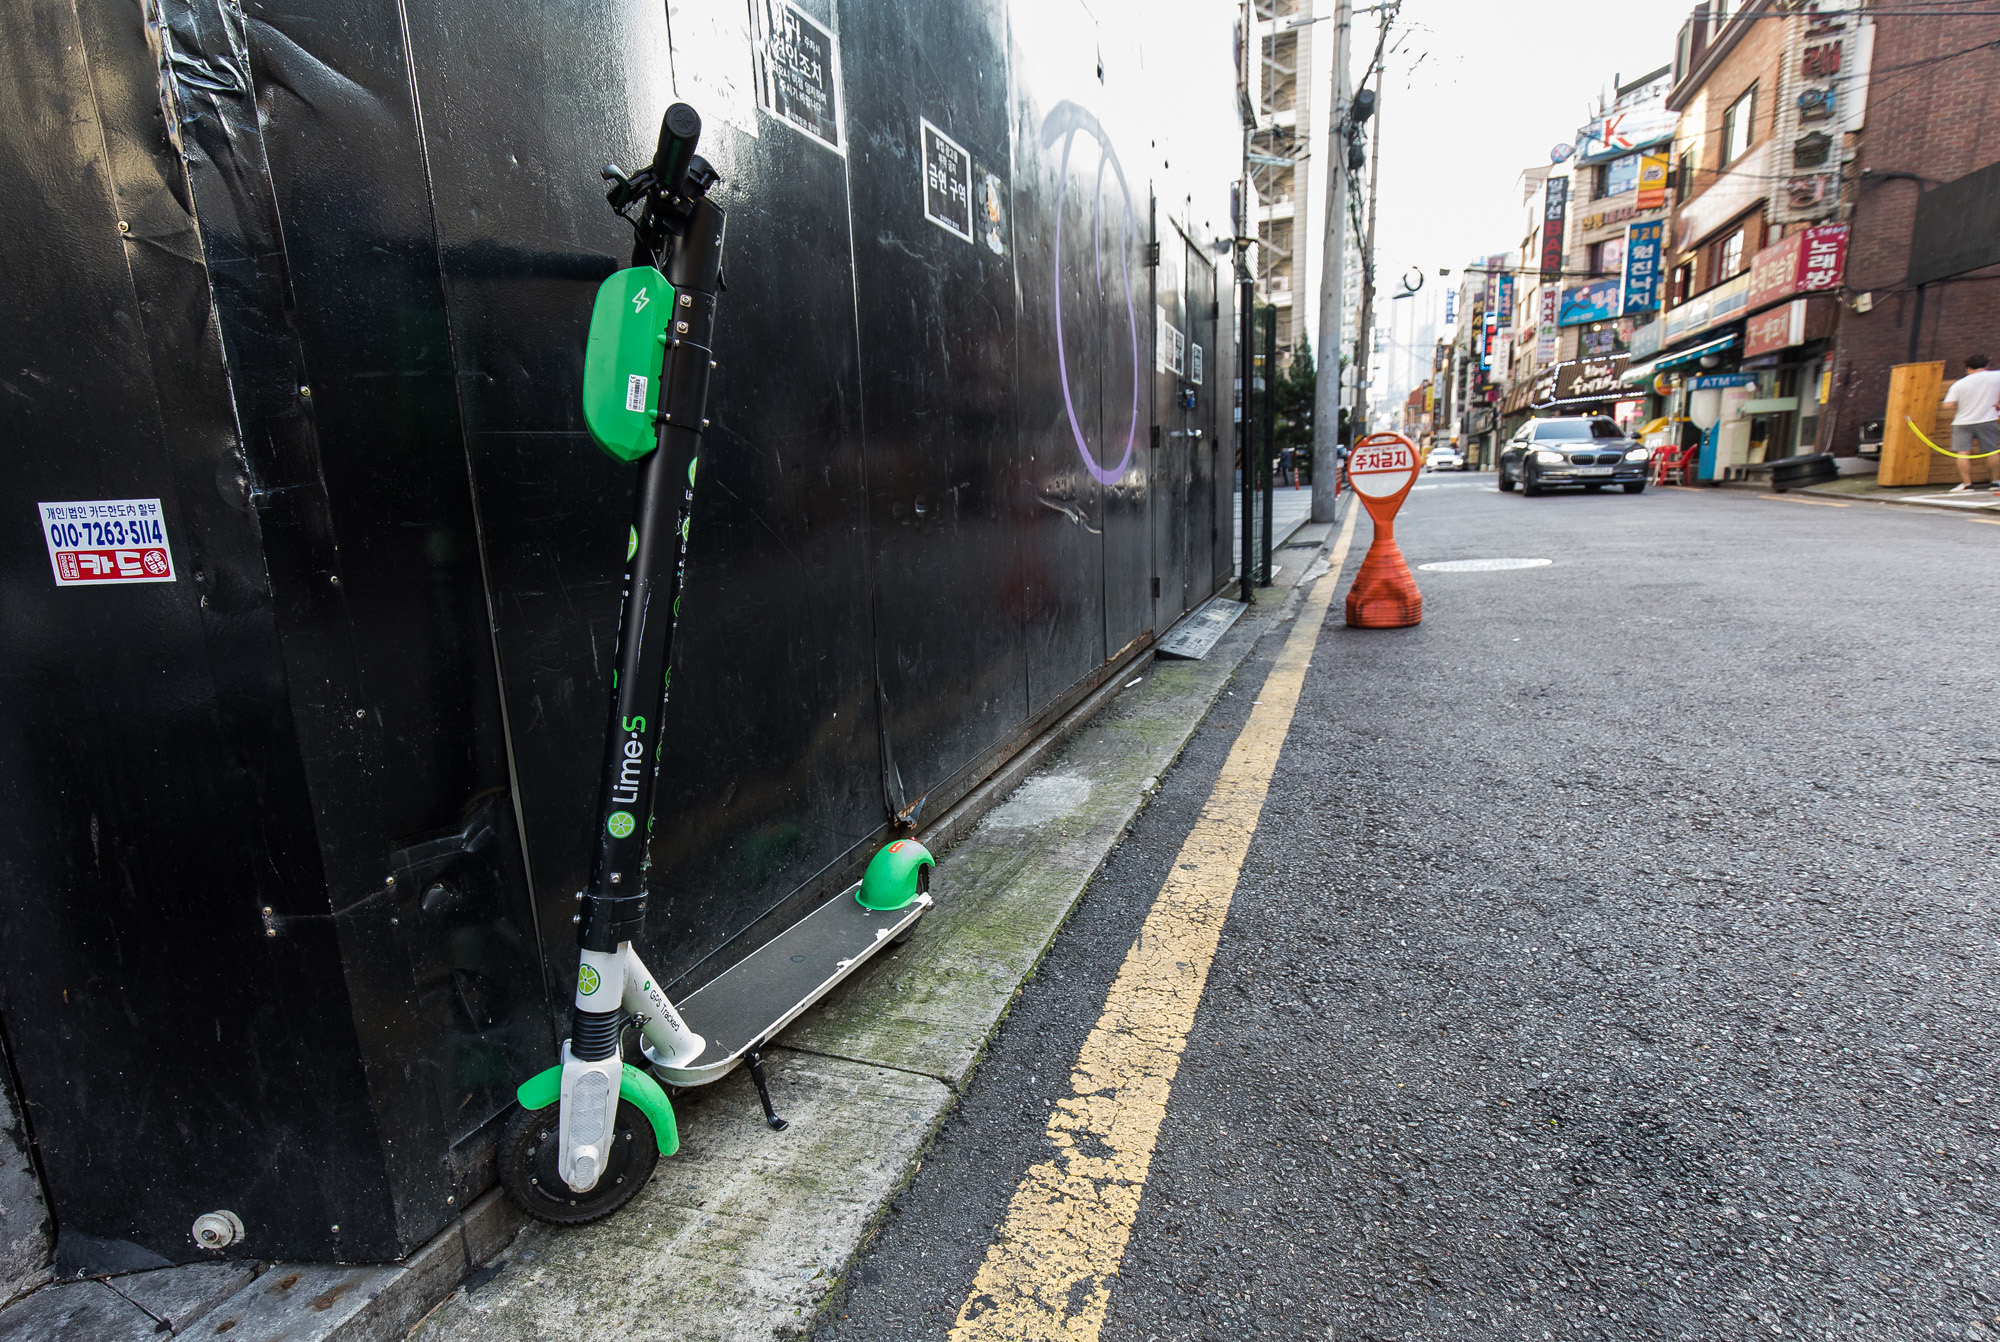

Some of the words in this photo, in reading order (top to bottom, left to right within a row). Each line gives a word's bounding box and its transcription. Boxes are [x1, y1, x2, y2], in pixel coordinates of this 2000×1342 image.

[929, 162, 947, 195] 금연
[950, 177, 967, 208] 구역
[1543, 220, 1562, 270] BAR
[1806, 239, 1838, 286] 노래방
[1701, 376, 1730, 388] ATM
[1355, 450, 1407, 470] 주차금지
[46, 506, 87, 520] 개인/법인
[138, 503, 157, 516] 할부
[78, 551, 144, 577] 카드
[650, 989, 662, 1008] GPS
[660, 1003, 680, 1032] Tracked
